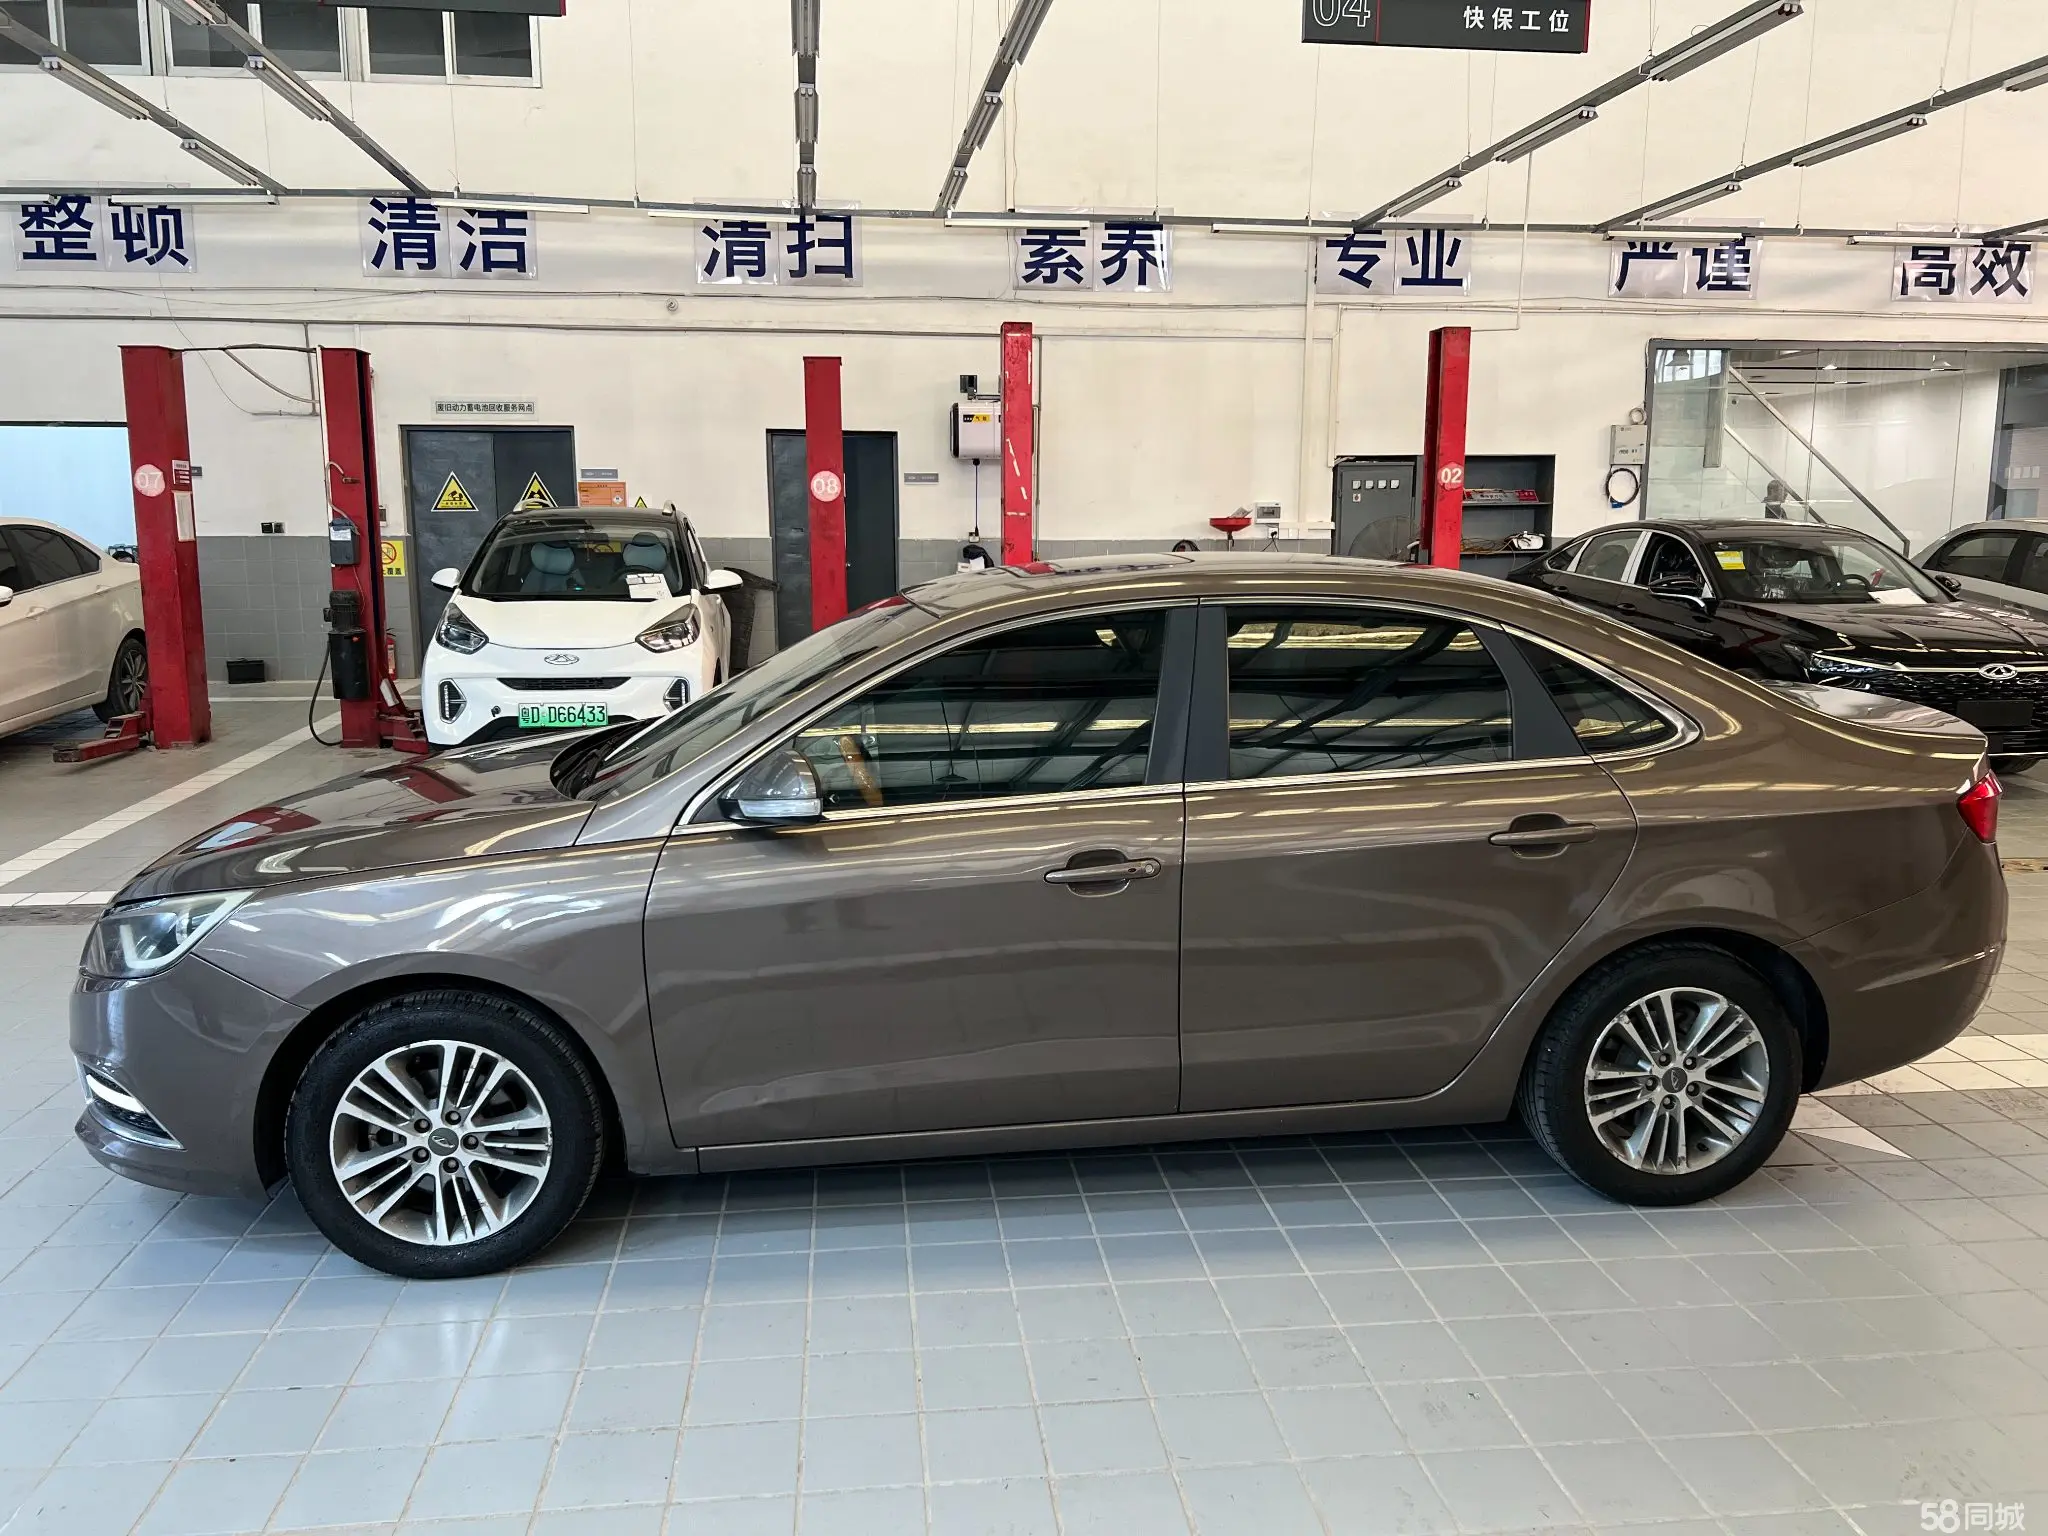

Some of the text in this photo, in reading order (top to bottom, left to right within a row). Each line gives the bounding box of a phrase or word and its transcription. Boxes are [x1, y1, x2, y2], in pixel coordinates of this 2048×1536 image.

[1312, 0, 1569, 33] 04 快保工位
[19, 194, 189, 266] 整顿
[368, 196, 529, 273] 清洁
[701, 213, 853, 279] 清扫
[1020, 221, 1165, 286] 素养
[1325, 228, 1463, 289] 专业
[1614, 235, 1756, 292] 严谨
[1900, 240, 2032, 297] 高效
[136, 472, 163, 489] 07
[813, 478, 838, 494] 08
[1441, 468, 1462, 483] 02
